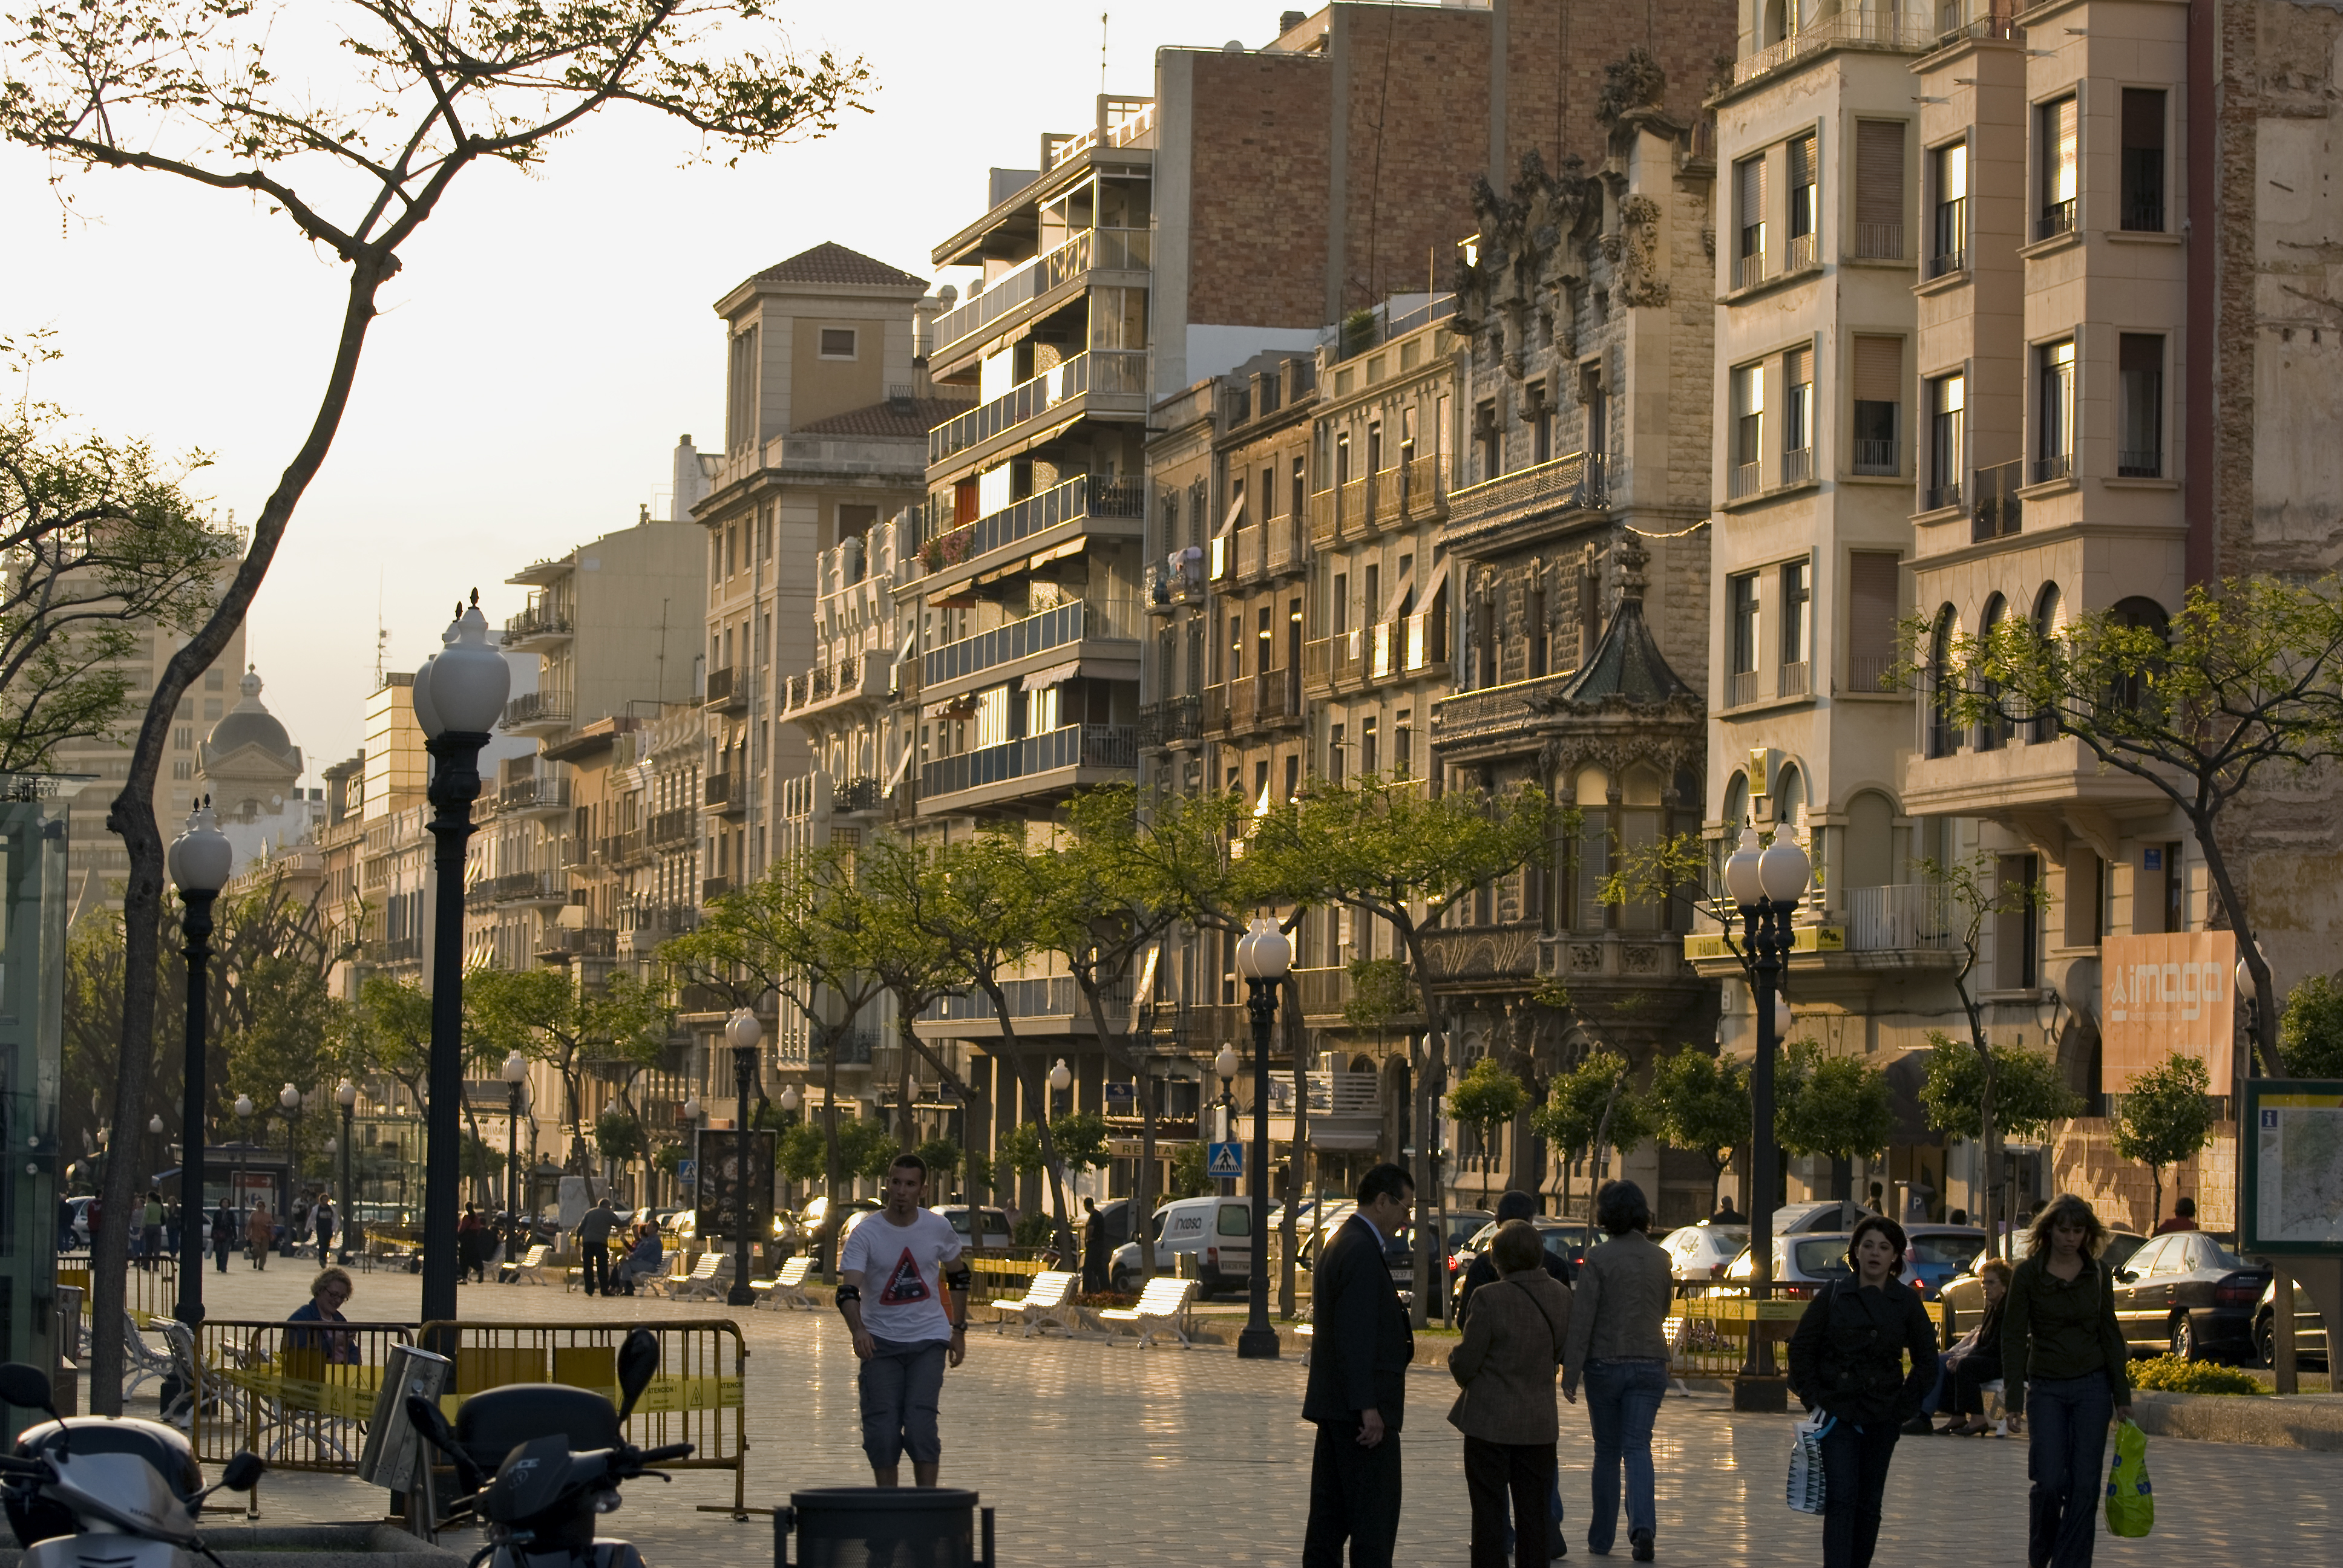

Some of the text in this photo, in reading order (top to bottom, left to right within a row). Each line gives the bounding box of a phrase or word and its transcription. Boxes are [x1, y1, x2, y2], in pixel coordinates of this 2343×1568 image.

[1698, 939, 1719, 956] RÀDIO
[2129, 962, 2223, 1021] imaga
[647, 1386, 673, 1394] ATENCION
